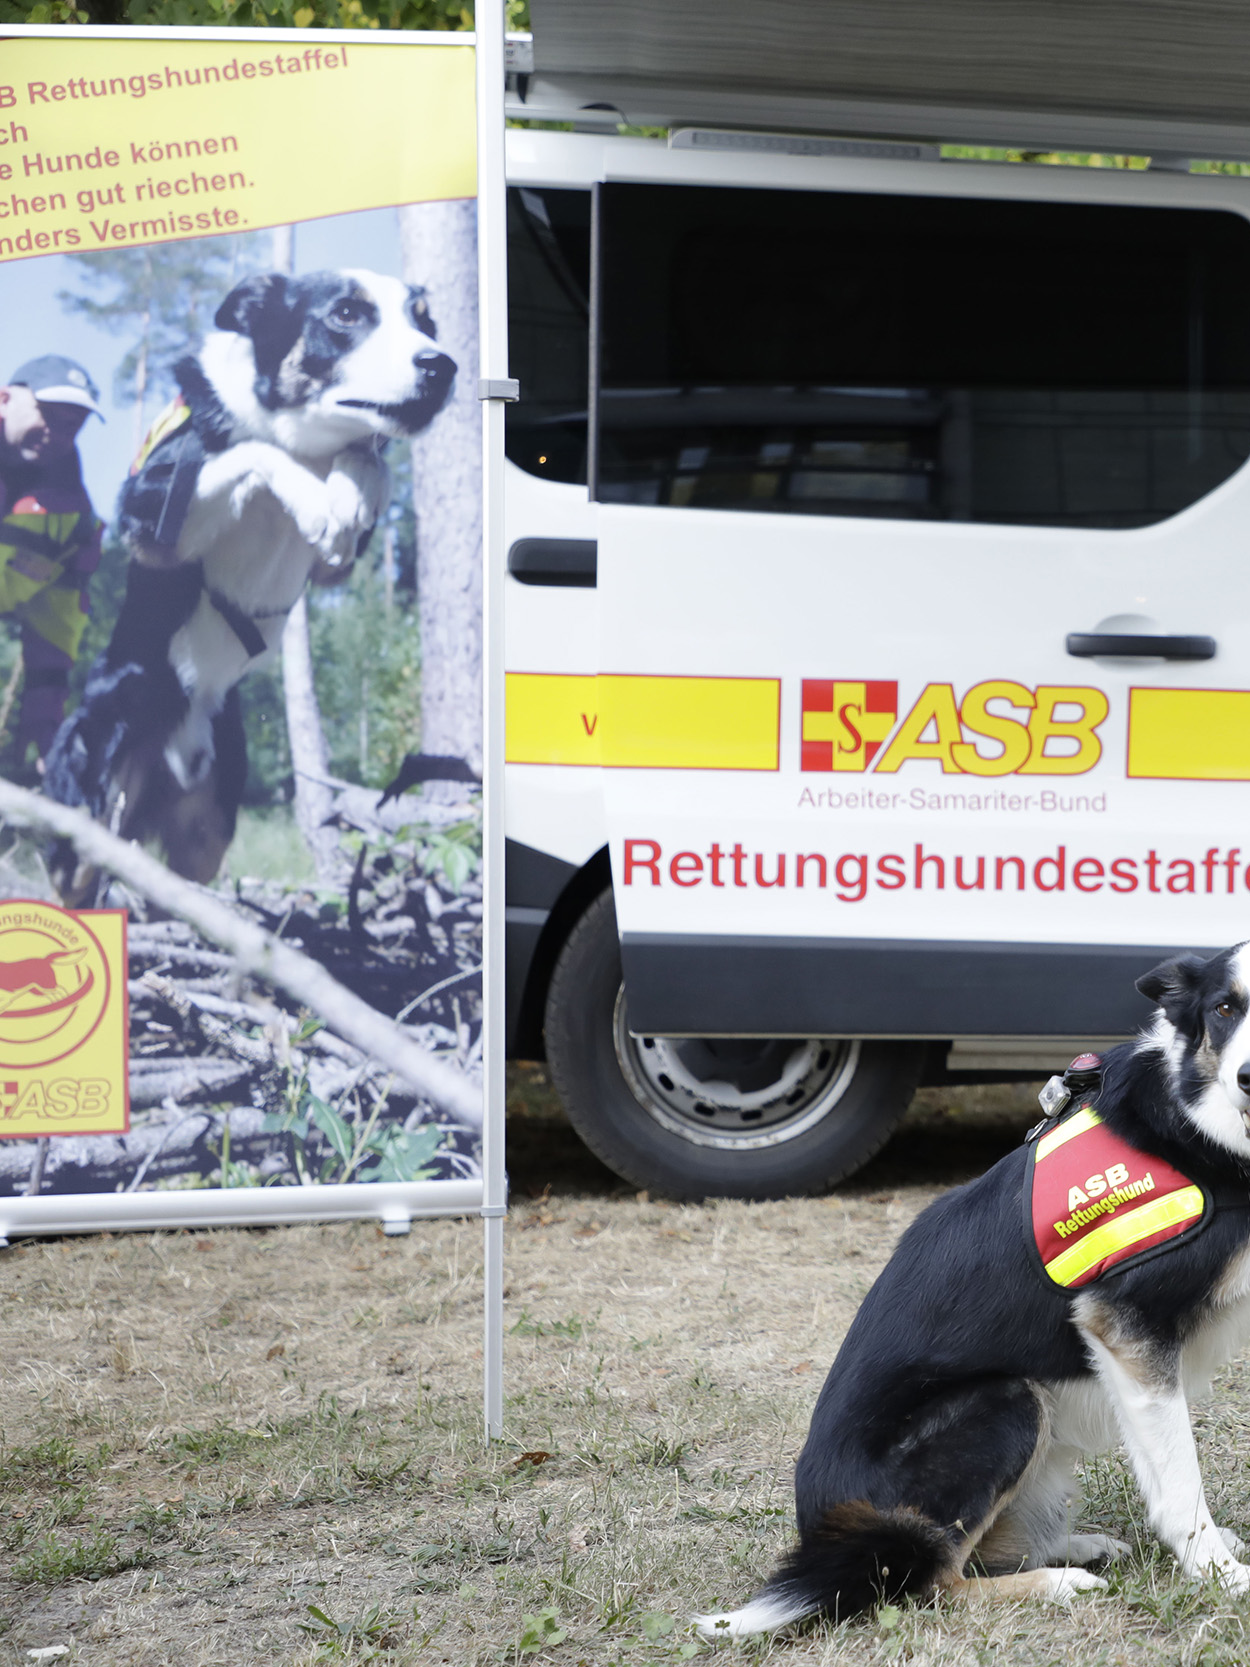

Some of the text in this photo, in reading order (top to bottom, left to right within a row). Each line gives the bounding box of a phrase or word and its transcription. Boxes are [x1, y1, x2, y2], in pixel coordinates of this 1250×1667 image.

[28, 47, 349, 105] Rettungshundestaffel
[23, 146, 121, 177] Hunde
[131, 135, 239, 164] können
[77, 183, 126, 213] gut
[135, 168, 255, 200] riechen.
[90, 207, 248, 242] Vermisste.
[871, 679, 1110, 777] ASB
[797, 786, 1107, 812] Arbeiter-Samariter-Bund
[0, 912, 79, 945] ngshunde
[8, 1078, 112, 1121] ASB
[1052, 1172, 1156, 1239] Rettungshund
[1068, 1163, 1130, 1213] ASB
